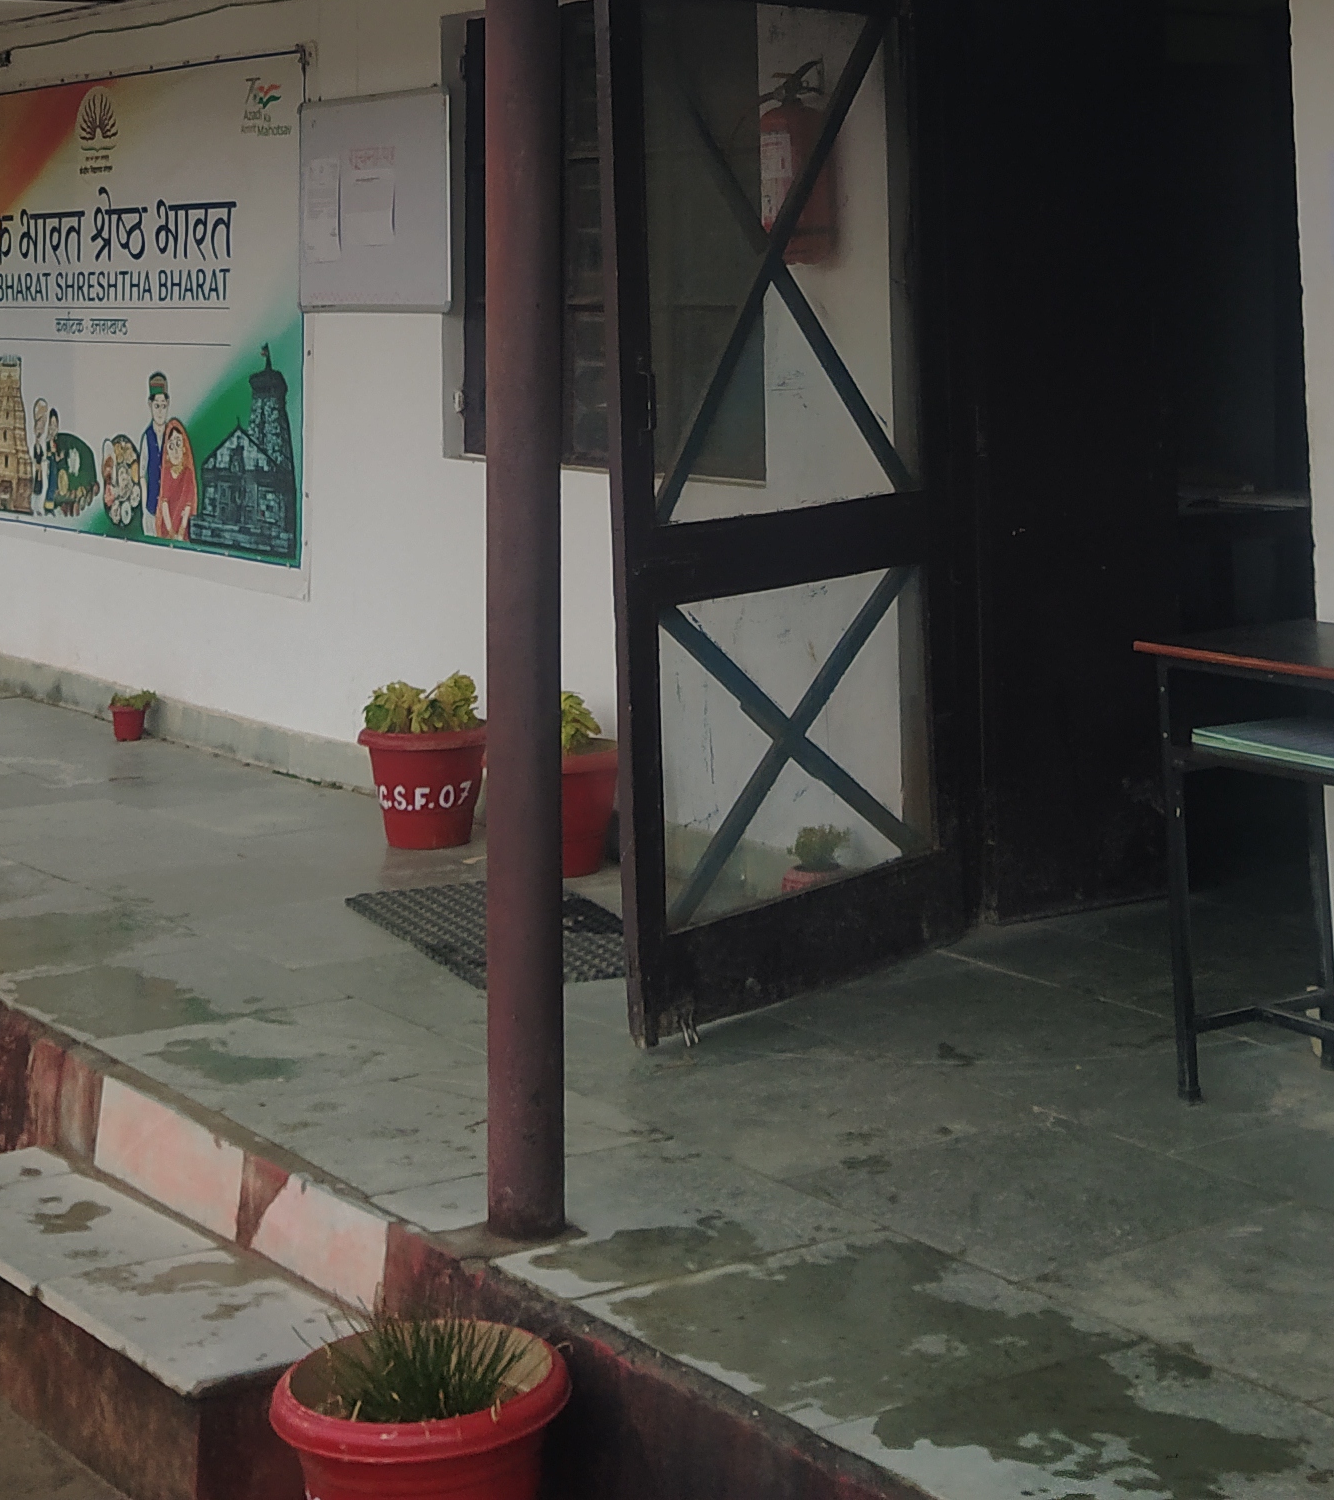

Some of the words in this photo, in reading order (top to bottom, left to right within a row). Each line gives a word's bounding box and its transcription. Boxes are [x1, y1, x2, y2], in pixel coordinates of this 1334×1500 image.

[19, 208, 85, 265] भारत
[90, 186, 148, 262] श्रेष्ठ
[155, 198, 237, 261] भारत
[55, 270, 153, 302] SHRESHTHA
[157, 268, 231, 302] BHARAT
